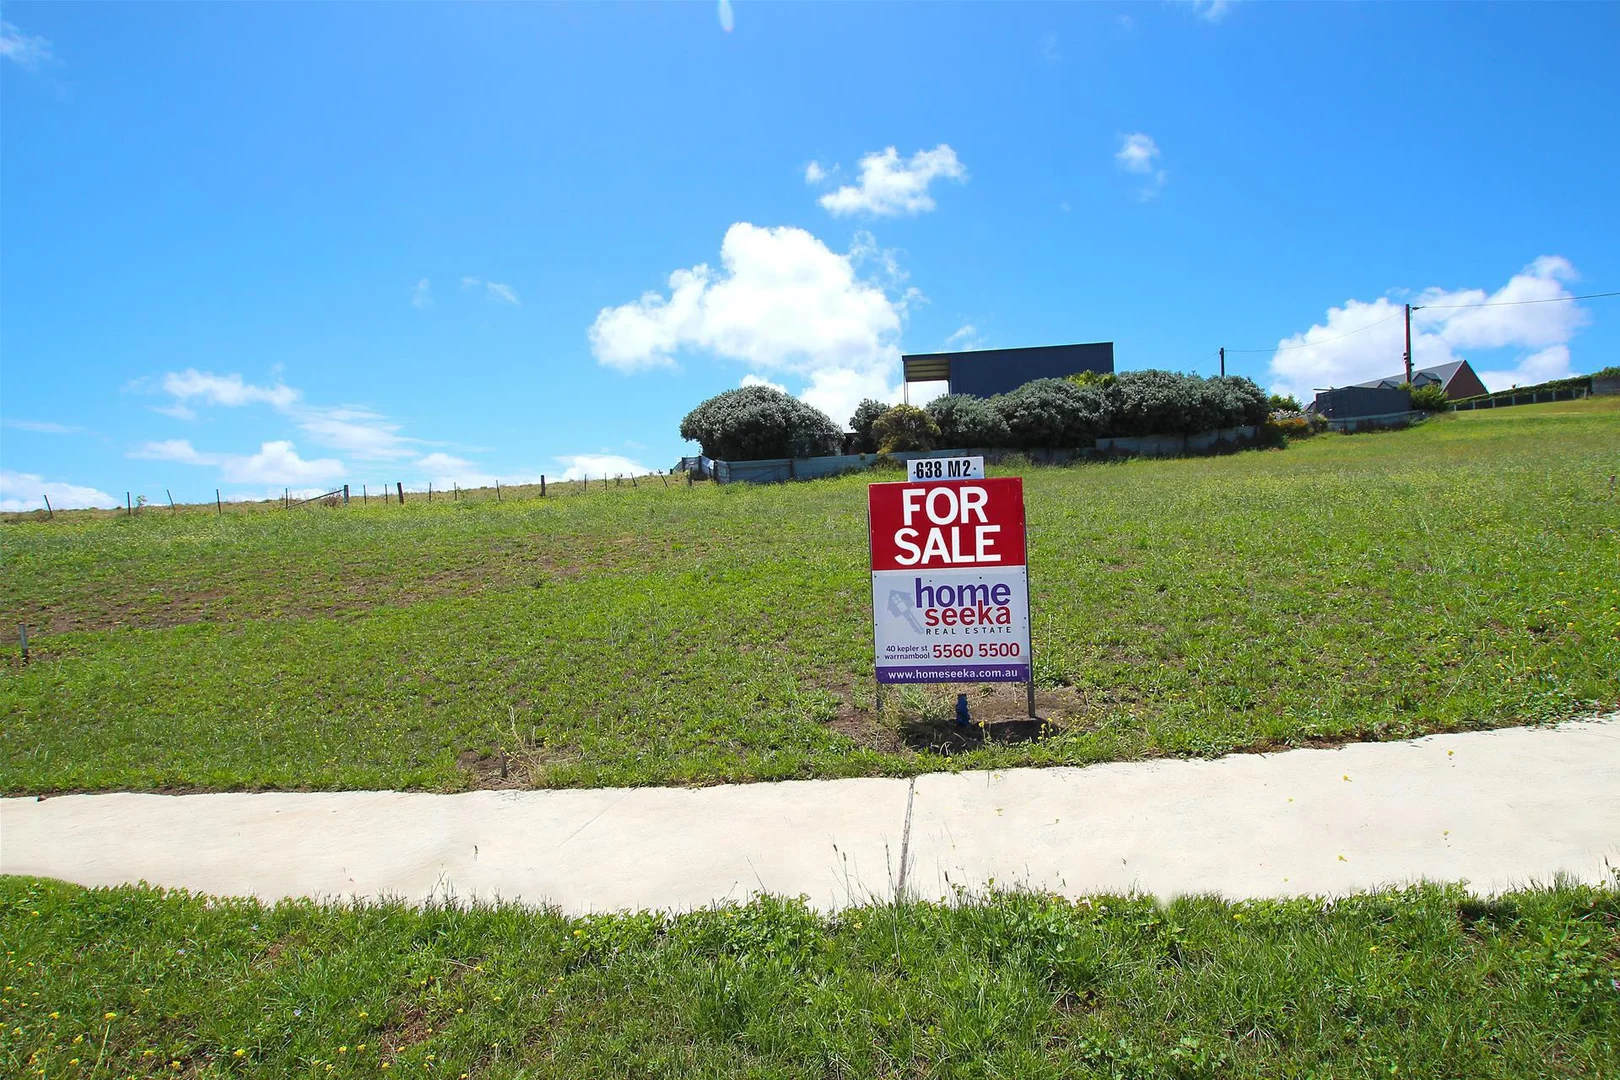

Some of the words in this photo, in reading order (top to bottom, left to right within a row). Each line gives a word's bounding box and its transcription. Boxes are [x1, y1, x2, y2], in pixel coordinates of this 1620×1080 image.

[916, 461, 942, 479] 638
[948, 460, 971, 478] M2
[902, 486, 989, 526] FOR
[894, 525, 1002, 566] SALE
[915, 577, 1011, 608] home
[925, 600, 1011, 627] seeka
[965, 626, 1012, 634] ESTATE
[884, 652, 930, 660] warrnambool
[897, 644, 919, 654] kepler
[932, 643, 974, 659] 5560
[978, 642, 1020, 658] 5500
[888, 668, 1018, 680] www.homeseeka.com.au
